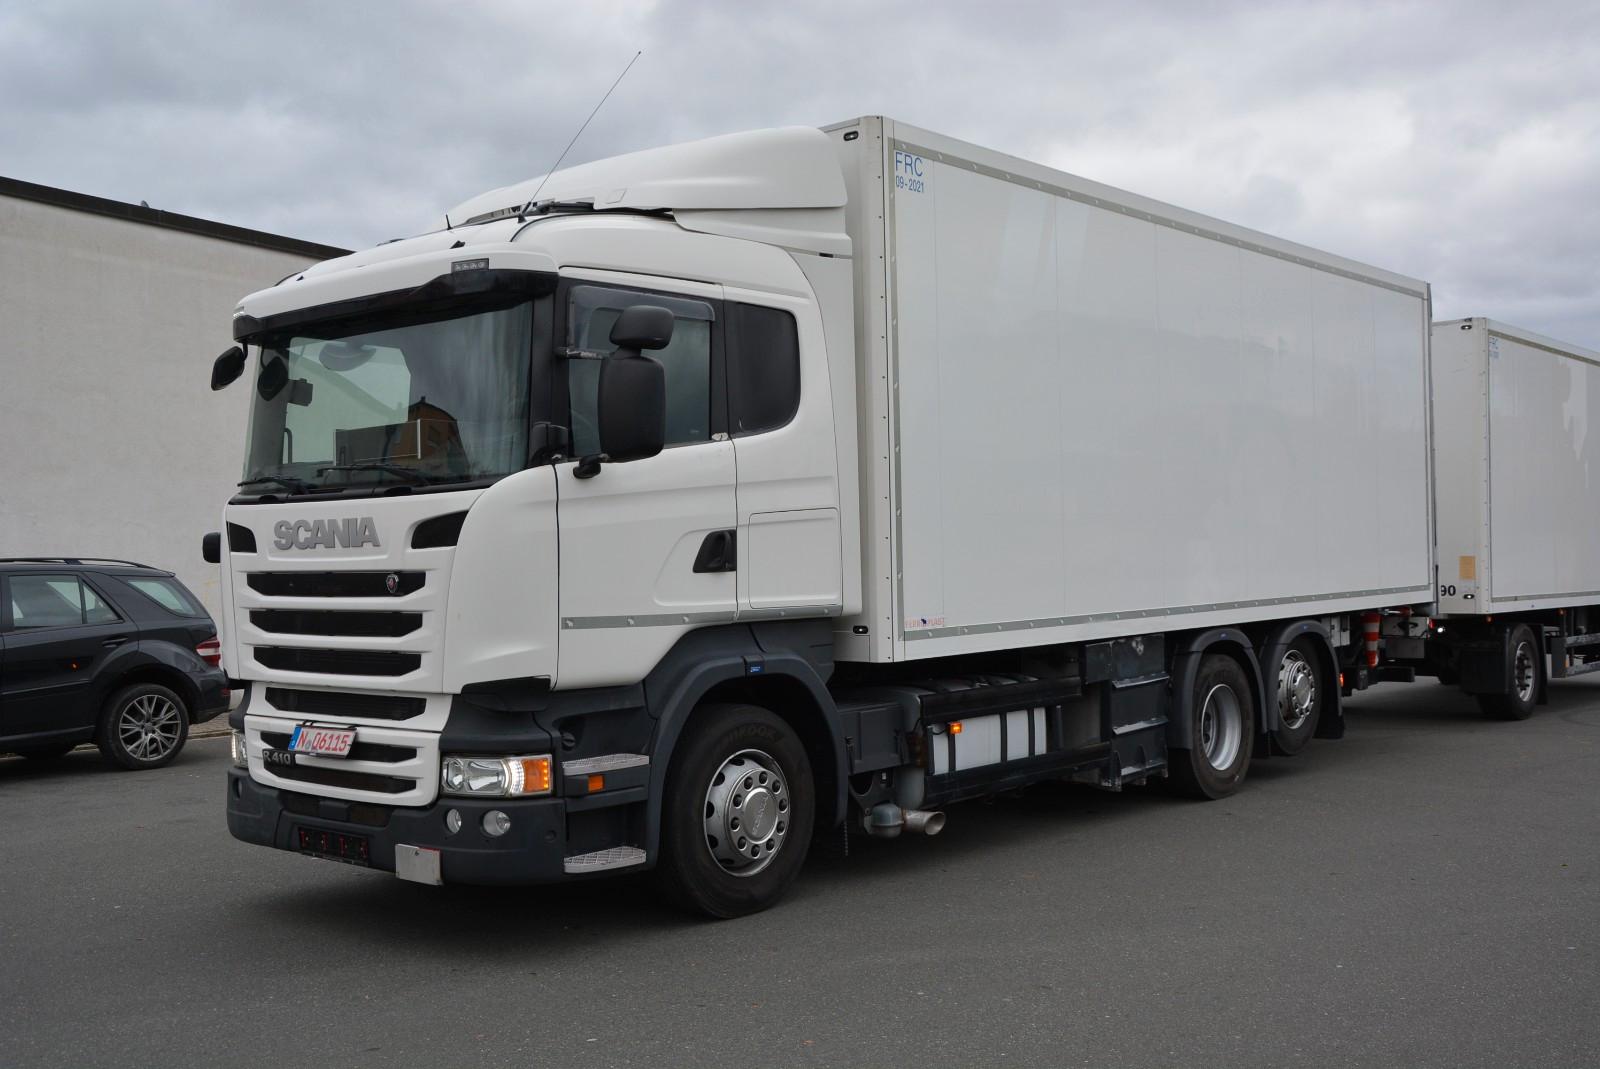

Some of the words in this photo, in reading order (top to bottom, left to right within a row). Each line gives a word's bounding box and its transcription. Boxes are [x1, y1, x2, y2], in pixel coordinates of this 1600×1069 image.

[896, 151, 923, 177] FRC
[273, 516, 381, 551] SCANIA
[297, 732, 307, 749] N
[312, 732, 351, 752] 06115
[263, 750, 271, 762] R
[272, 751, 291, 765] 410
